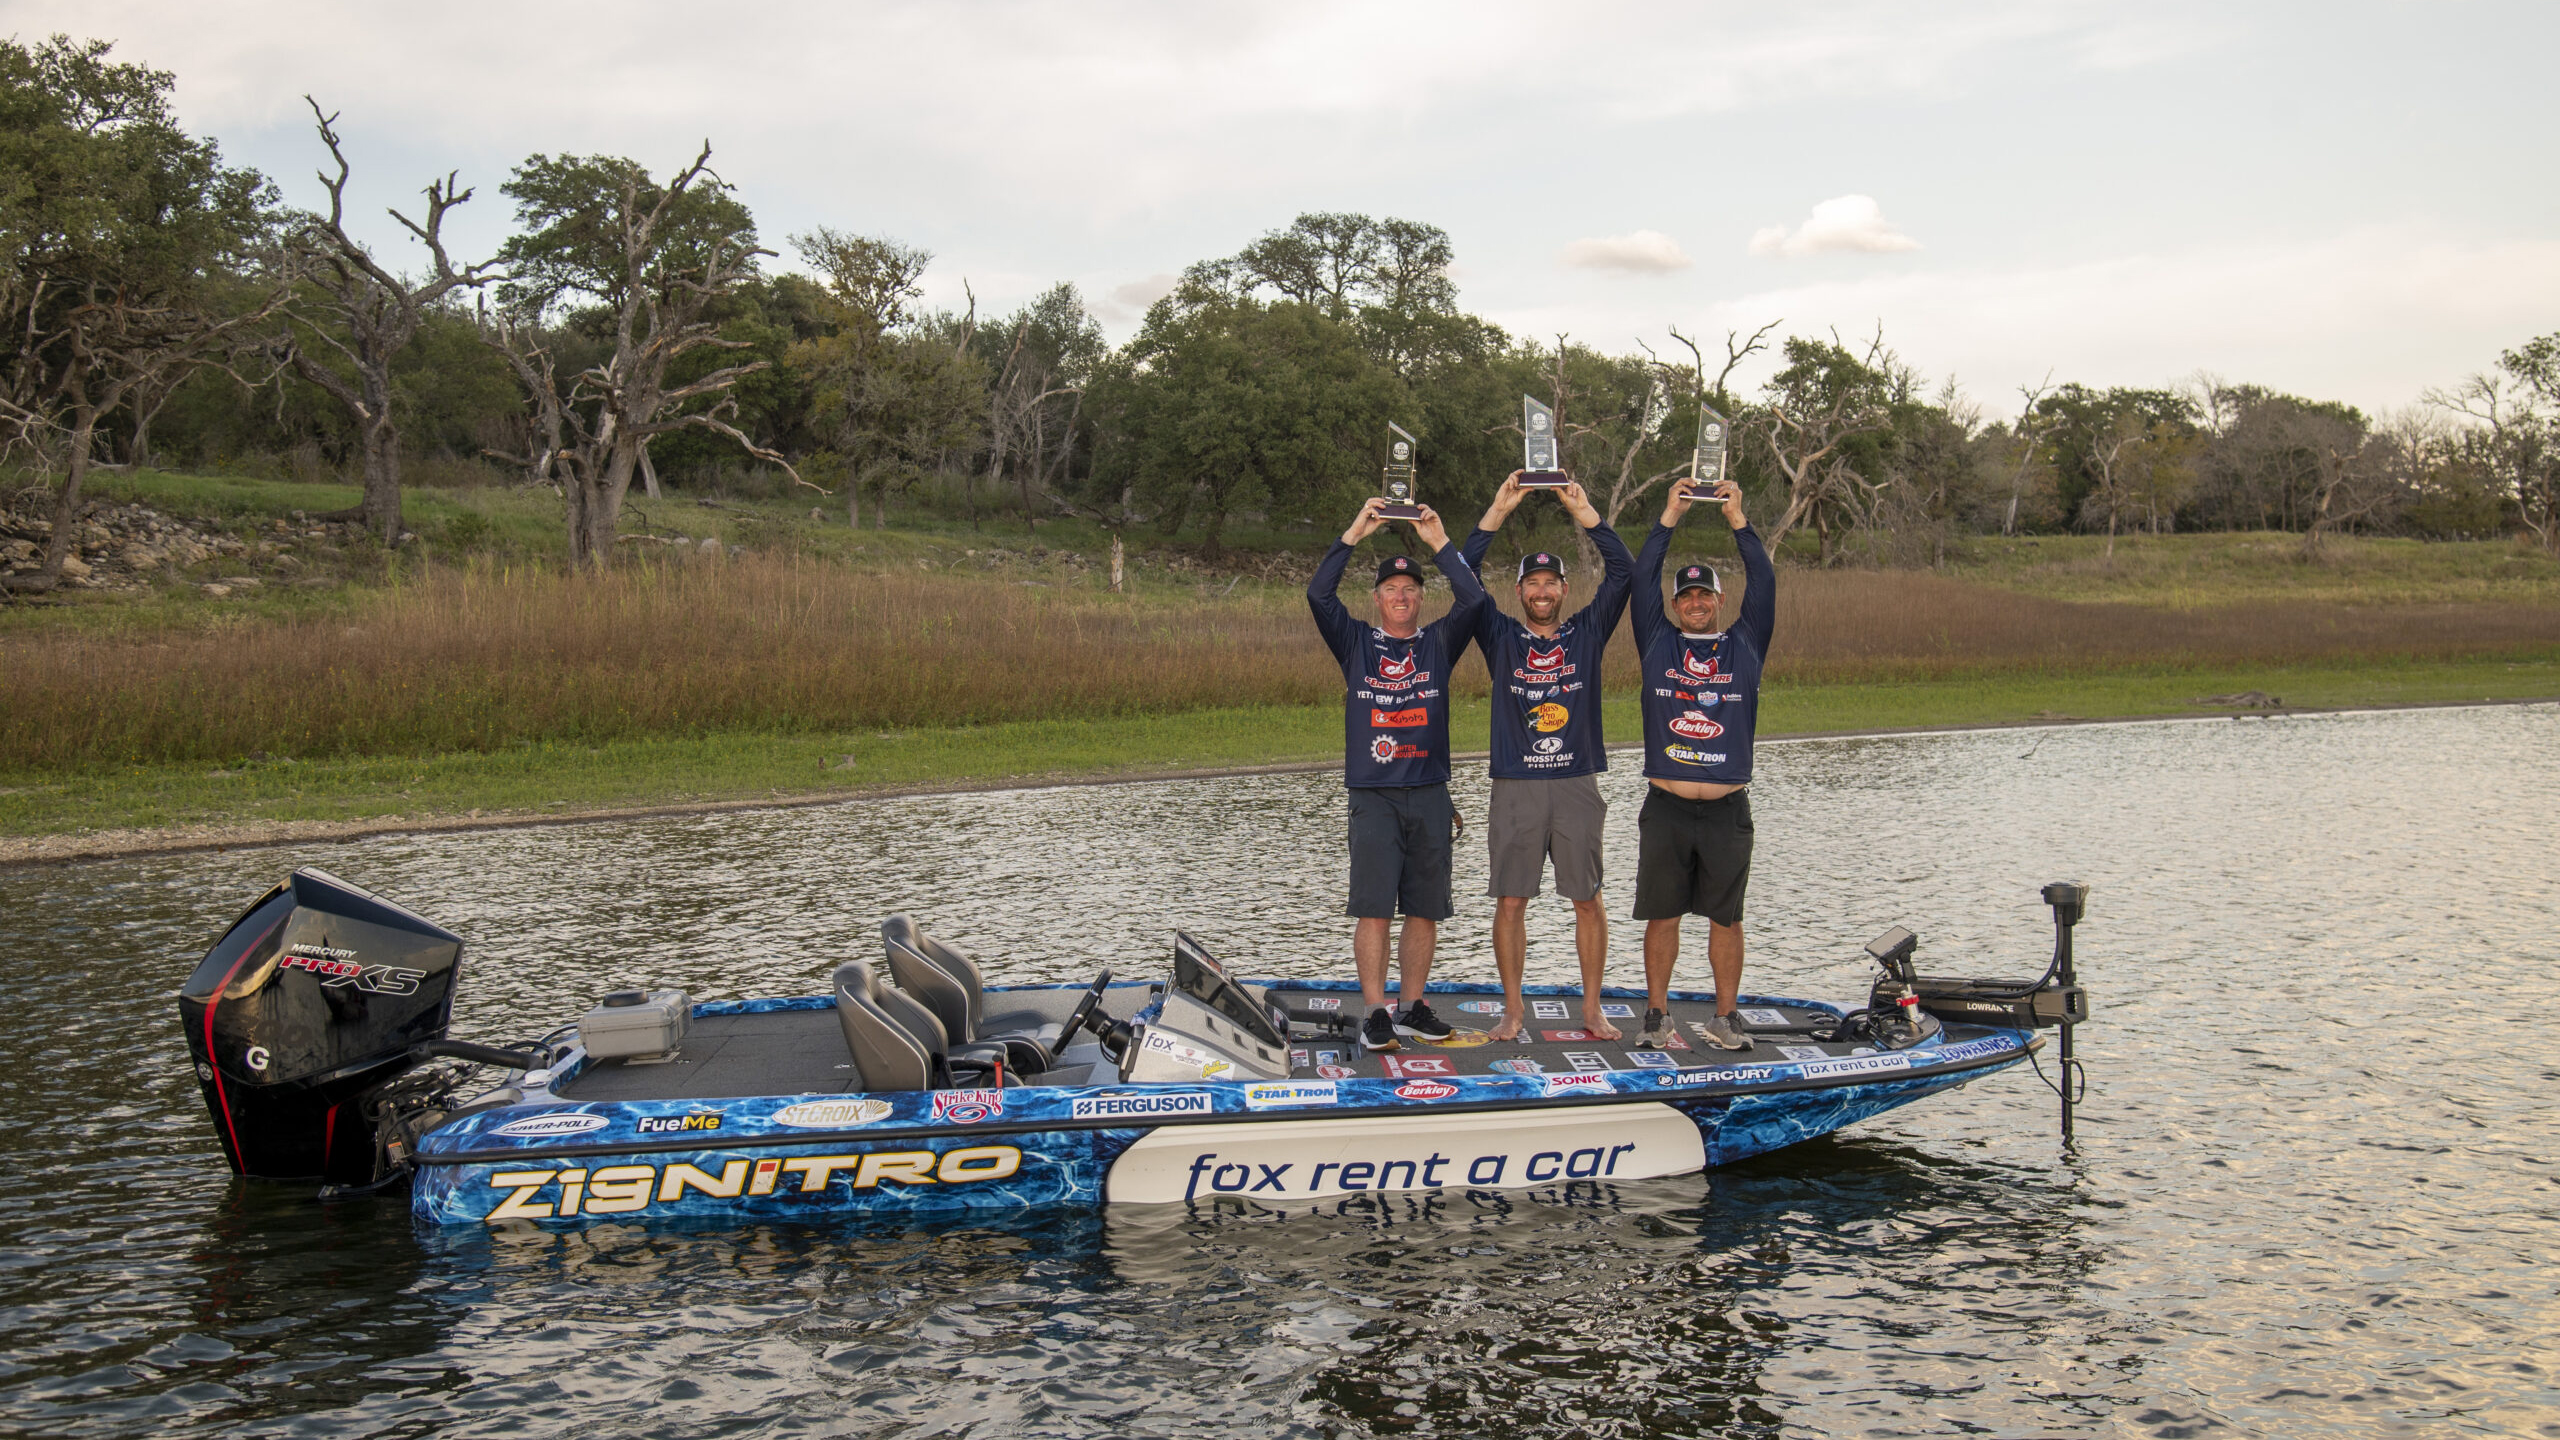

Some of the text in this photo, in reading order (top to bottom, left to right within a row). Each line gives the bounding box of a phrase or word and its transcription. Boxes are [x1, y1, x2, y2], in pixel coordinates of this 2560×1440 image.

[1356, 690, 1374, 699] YETI
[1655, 688, 1672, 697] YETI
[1540, 704, 1559, 713] Bass
[1542, 712, 1556, 721] Pro
[1543, 719, 1565, 728] Shops
[1674, 720, 1718, 737] Berkley
[1523, 752, 1574, 763] MOSSY OAK
[1668, 748, 1726, 762] STAR TRON
[1528, 761, 1570, 769] FISHING
[291, 943, 358, 959] MERCURY
[279, 955, 427, 996] PRO XS
[1145, 1032, 1175, 1051] fox
[1939, 1037, 2016, 1062] LOWRANCE
[247, 1046, 270, 1070] G
[1803, 1055, 1905, 1077] fox rent a car
[1552, 1074, 1602, 1086] SONIC
[1676, 1068, 1772, 1085] MERCURY
[1252, 1087, 1334, 1100] STAR TRON
[1403, 1082, 1451, 1097] Berkley
[932, 1088, 1003, 1119] Strike King
[1096, 1096, 1204, 1115] FERGUSON
[503, 1119, 594, 1132] POWER-POLE
[1184, 1141, 1636, 1200] fox rent a car
